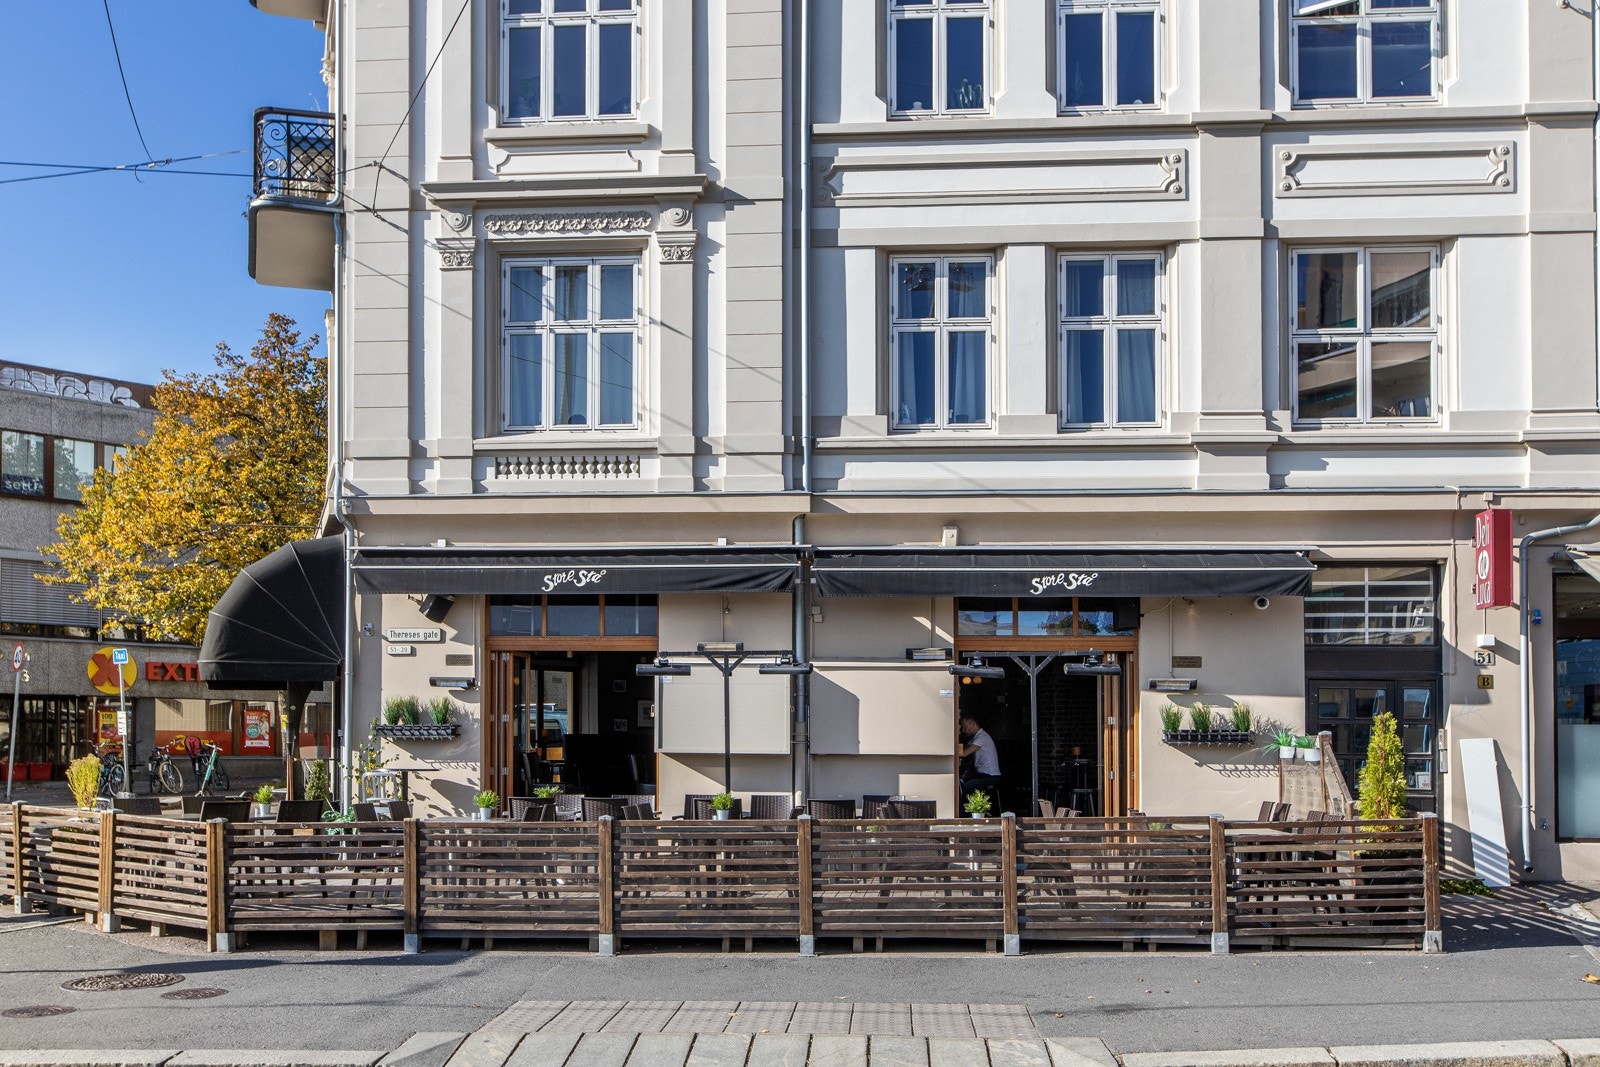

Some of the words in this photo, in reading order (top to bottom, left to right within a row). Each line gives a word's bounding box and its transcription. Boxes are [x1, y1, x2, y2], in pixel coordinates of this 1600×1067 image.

[1476, 514, 1489, 549] Deli
[1479, 551, 1488, 578] de
[541, 570, 575, 592] Store
[573, 570, 606, 587] Stå
[1030, 573, 1064, 595] Store
[1063, 572, 1098, 590] Stå
[1476, 575, 1490, 606] Luca
[390, 630, 420, 639] Thereses
[423, 631, 438, 641] gate
[115, 651, 125, 660] Taxi
[1477, 652, 1492, 664] 51
[146, 661, 204, 682] EXT
[1482, 676, 1490, 687] B
